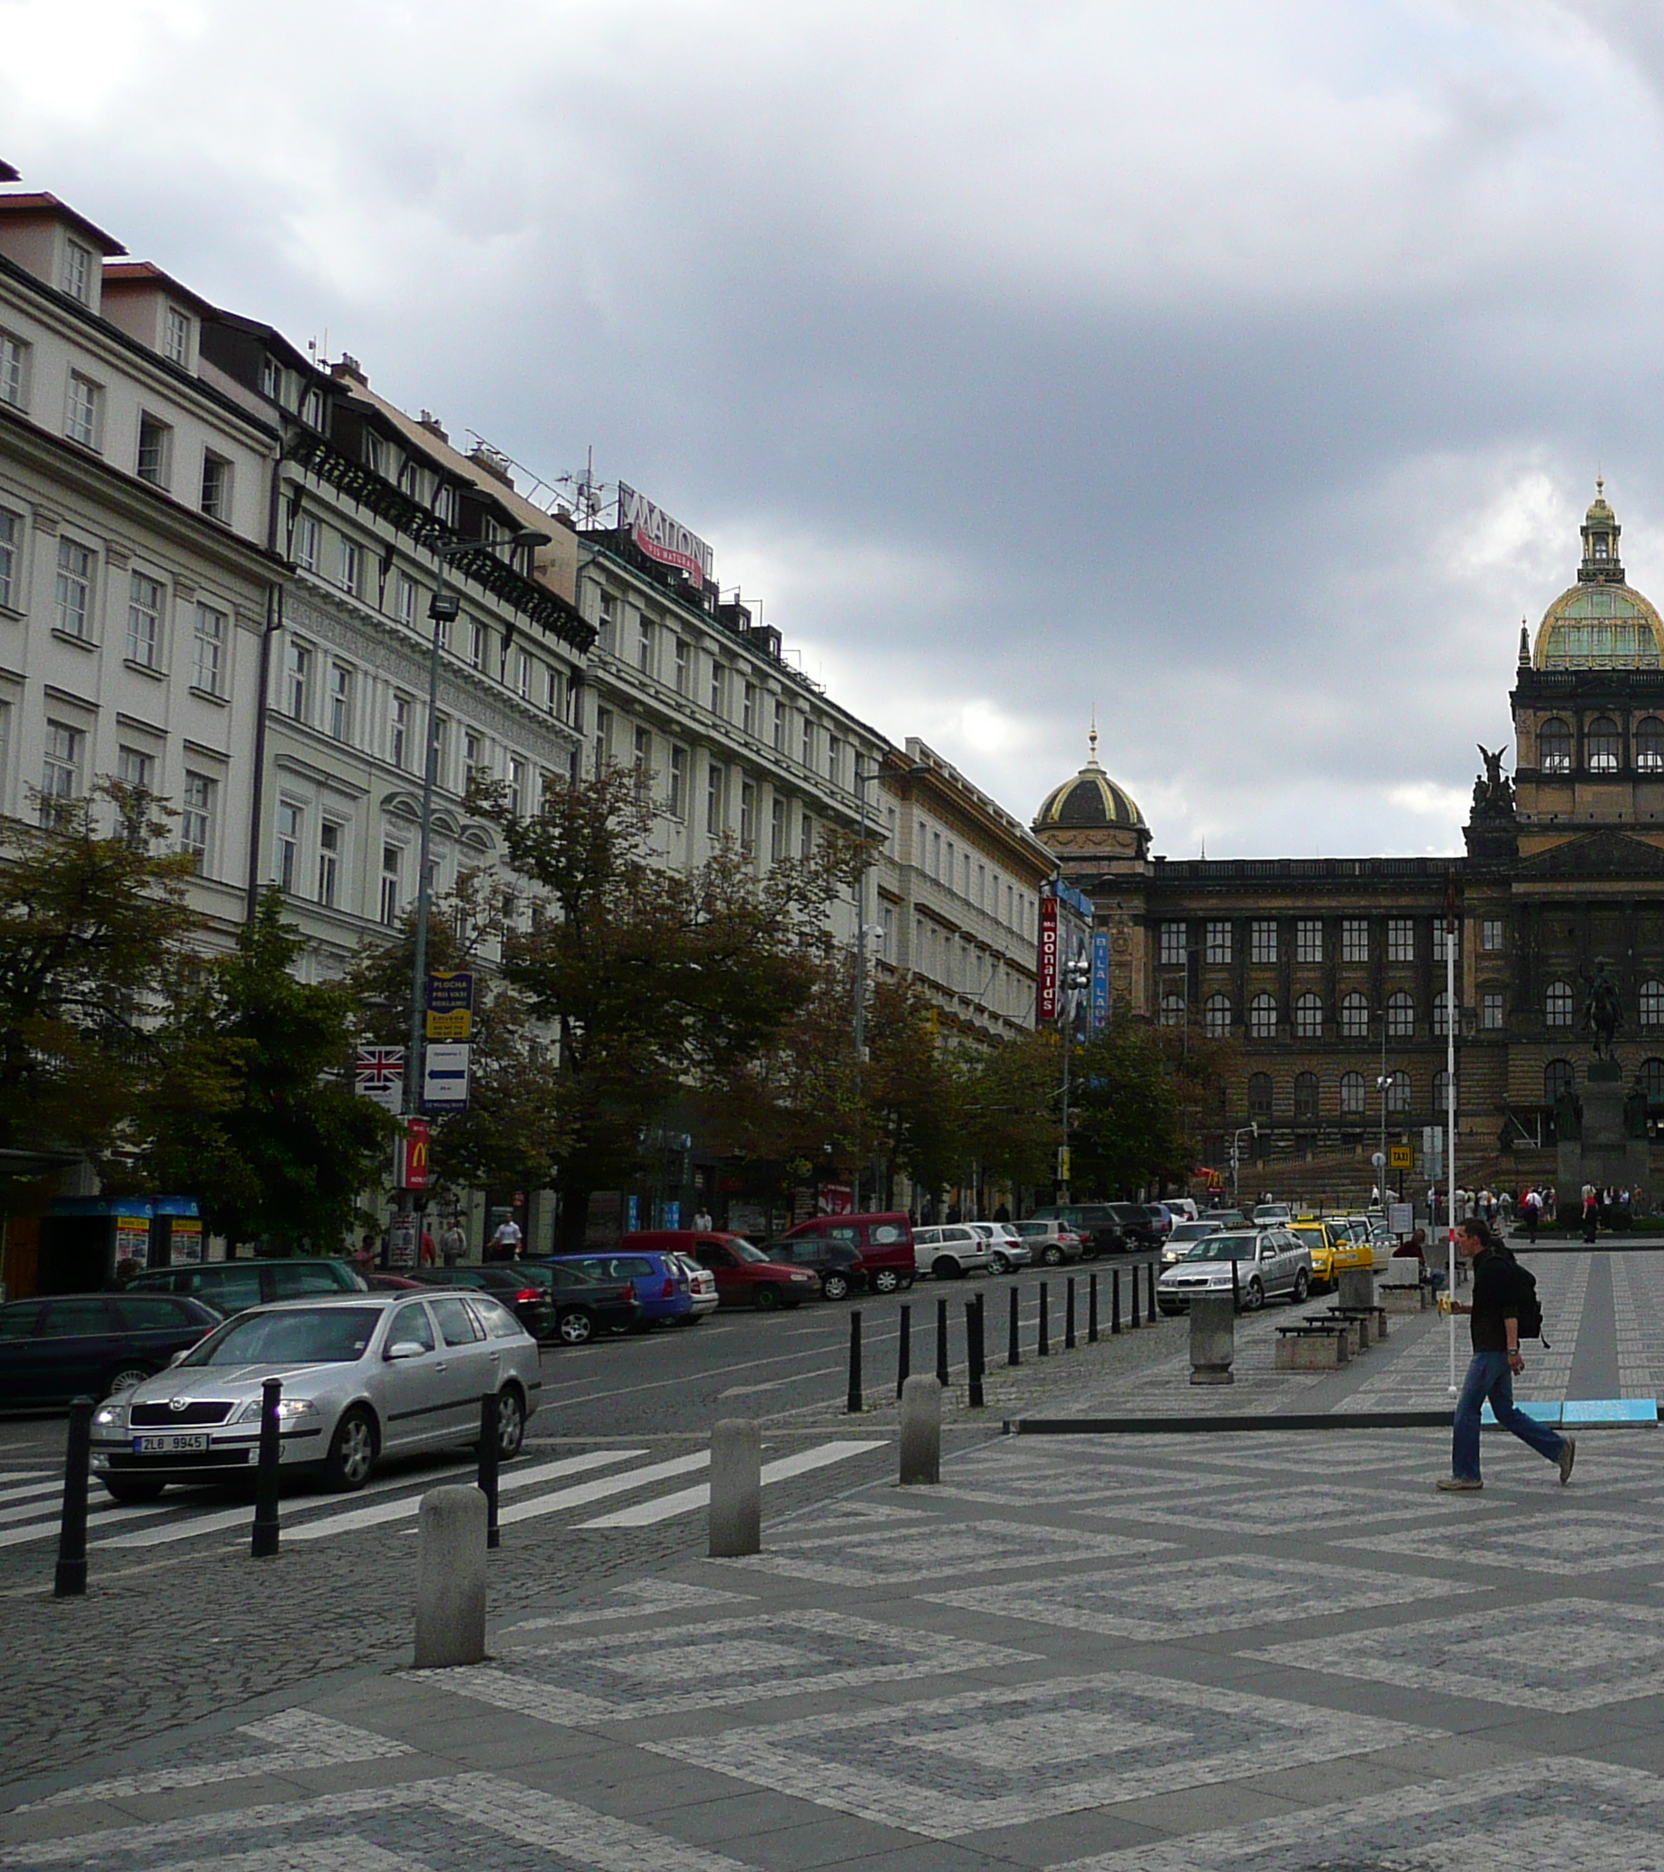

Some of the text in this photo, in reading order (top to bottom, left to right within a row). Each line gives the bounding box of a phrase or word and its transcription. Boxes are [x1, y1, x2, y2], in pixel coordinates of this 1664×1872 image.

[434, 981, 467, 989] PLOCHA
[1393, 1152, 1408, 1161] TAXI
[144, 1436, 202, 1450] 2L8 9945
